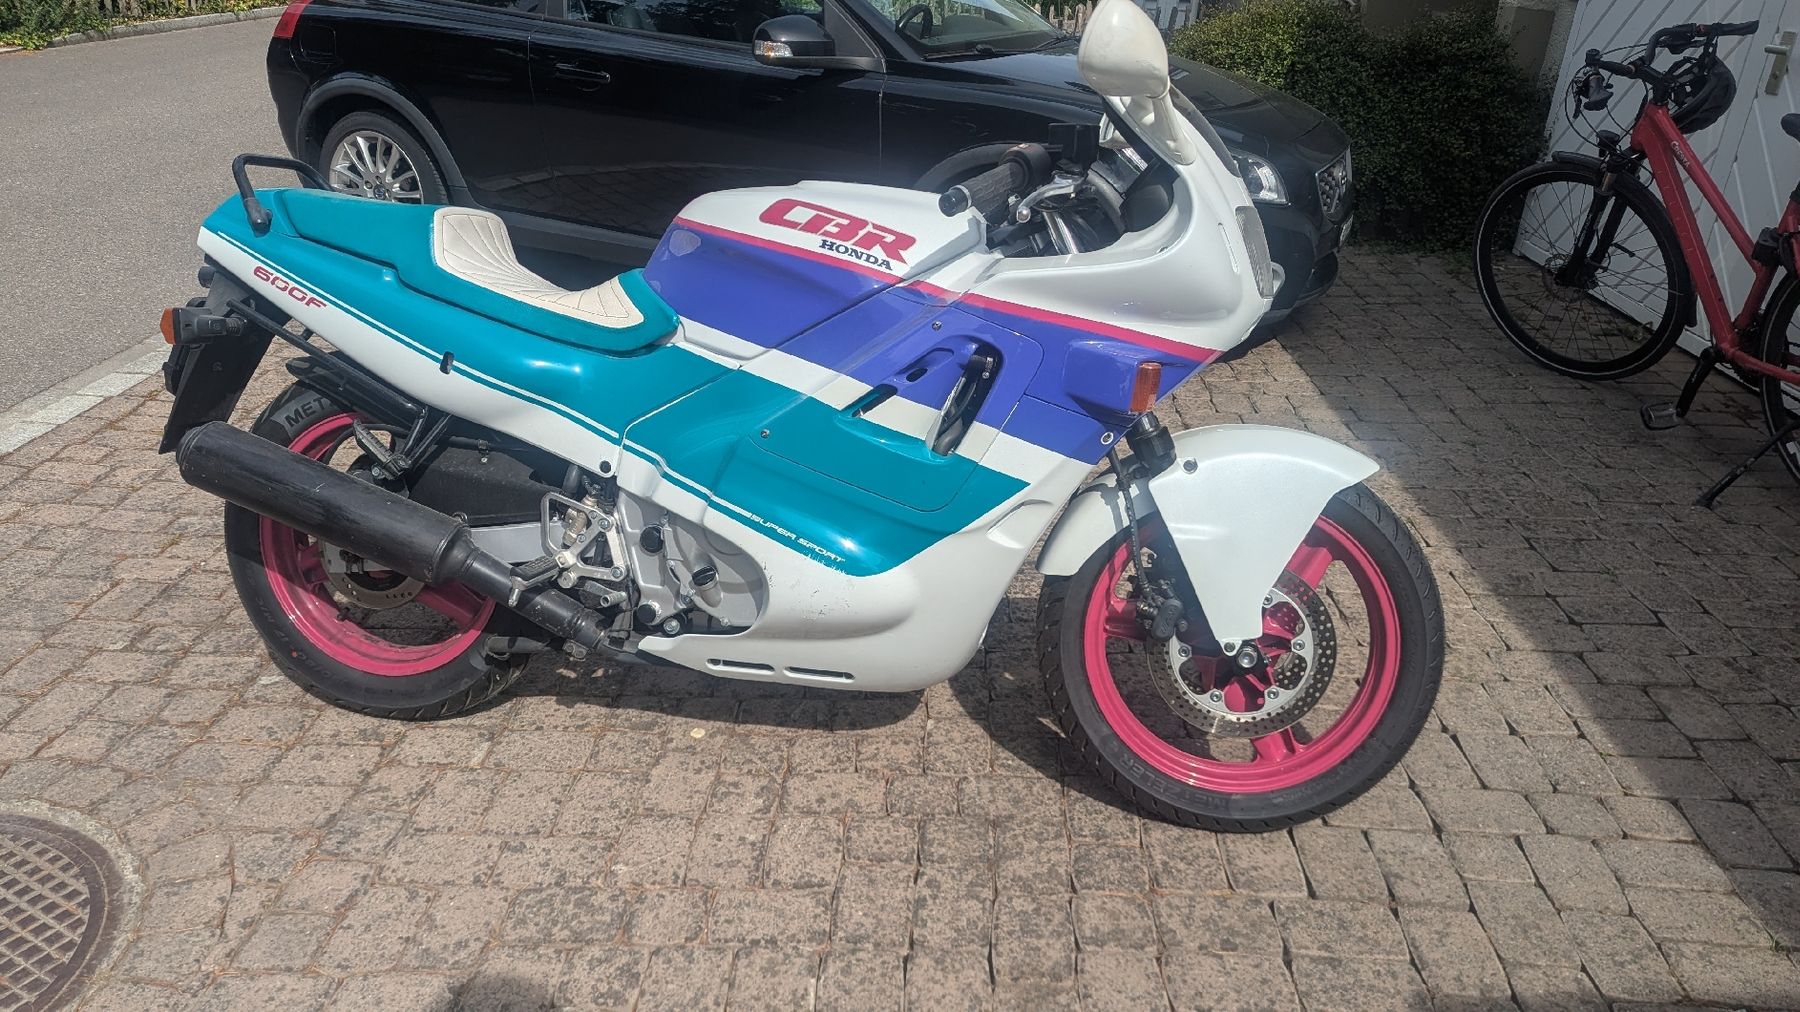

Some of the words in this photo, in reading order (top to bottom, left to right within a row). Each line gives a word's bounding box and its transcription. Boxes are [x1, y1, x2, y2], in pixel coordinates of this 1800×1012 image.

[759, 198, 917, 265] CBR
[819, 239, 893, 271] HONDA
[253, 266, 327, 308] 600F
[750, 514, 797, 541] SUPER
[797, 537, 846, 562] SPORT
